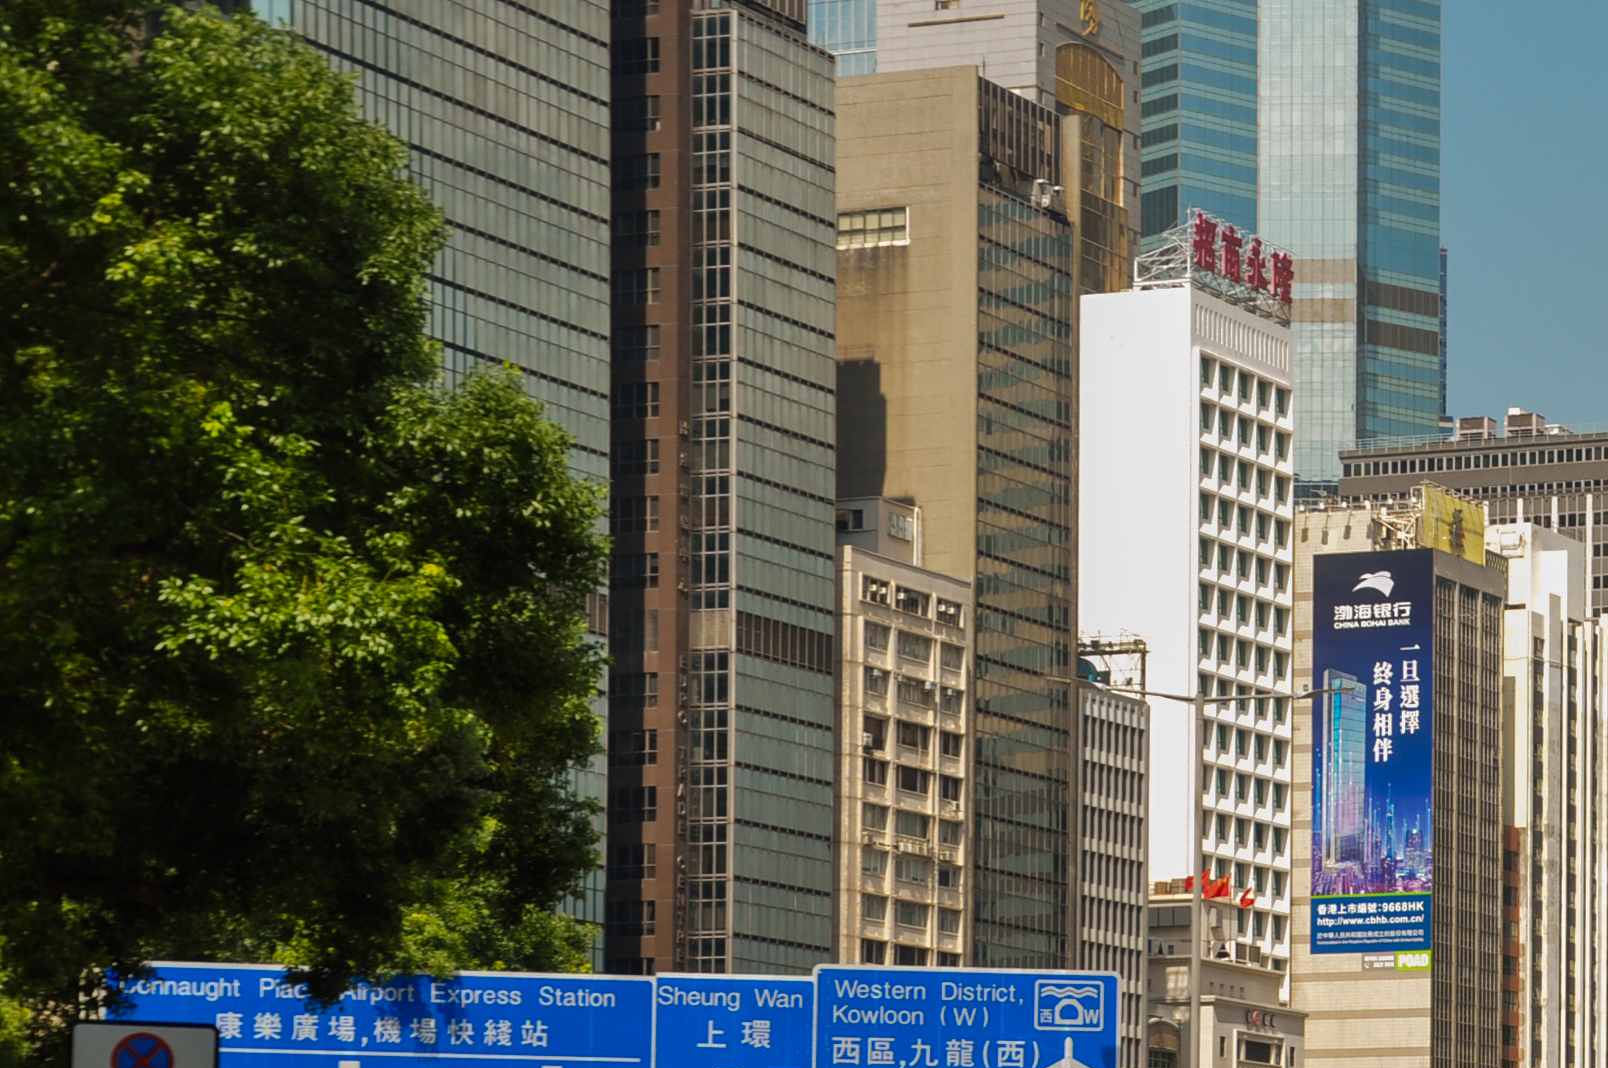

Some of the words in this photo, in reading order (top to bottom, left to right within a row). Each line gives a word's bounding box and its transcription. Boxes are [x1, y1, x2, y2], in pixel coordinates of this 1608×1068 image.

[1334, 602, 1411, 620] 渤海银行
[1334, 621, 1359, 629] CHINA
[1361, 619, 1386, 627] BOHAI
[1388, 618, 1410, 626] BANK
[1400, 644, 1420, 734] 一旦選擇
[1373, 661, 1393, 762] 終身相伴
[1317, 914, 1424, 927] http://www.cbhb.com.cn/
[259, 977, 312, 999] Plac
[430, 983, 522, 1007] Express
[539, 985, 616, 1007] Station
[658, 985, 740, 1011] Sheung
[755, 989, 803, 1008] Wan
[834, 980, 926, 1001] Western
[941, 982, 1024, 1004] District,
[832, 1005, 924, 1025] Kowloon
[1039, 1008, 1053, 1024] 西
[1083, 1009, 1098, 1024] W
[697, 1020, 771, 1048] 上環
